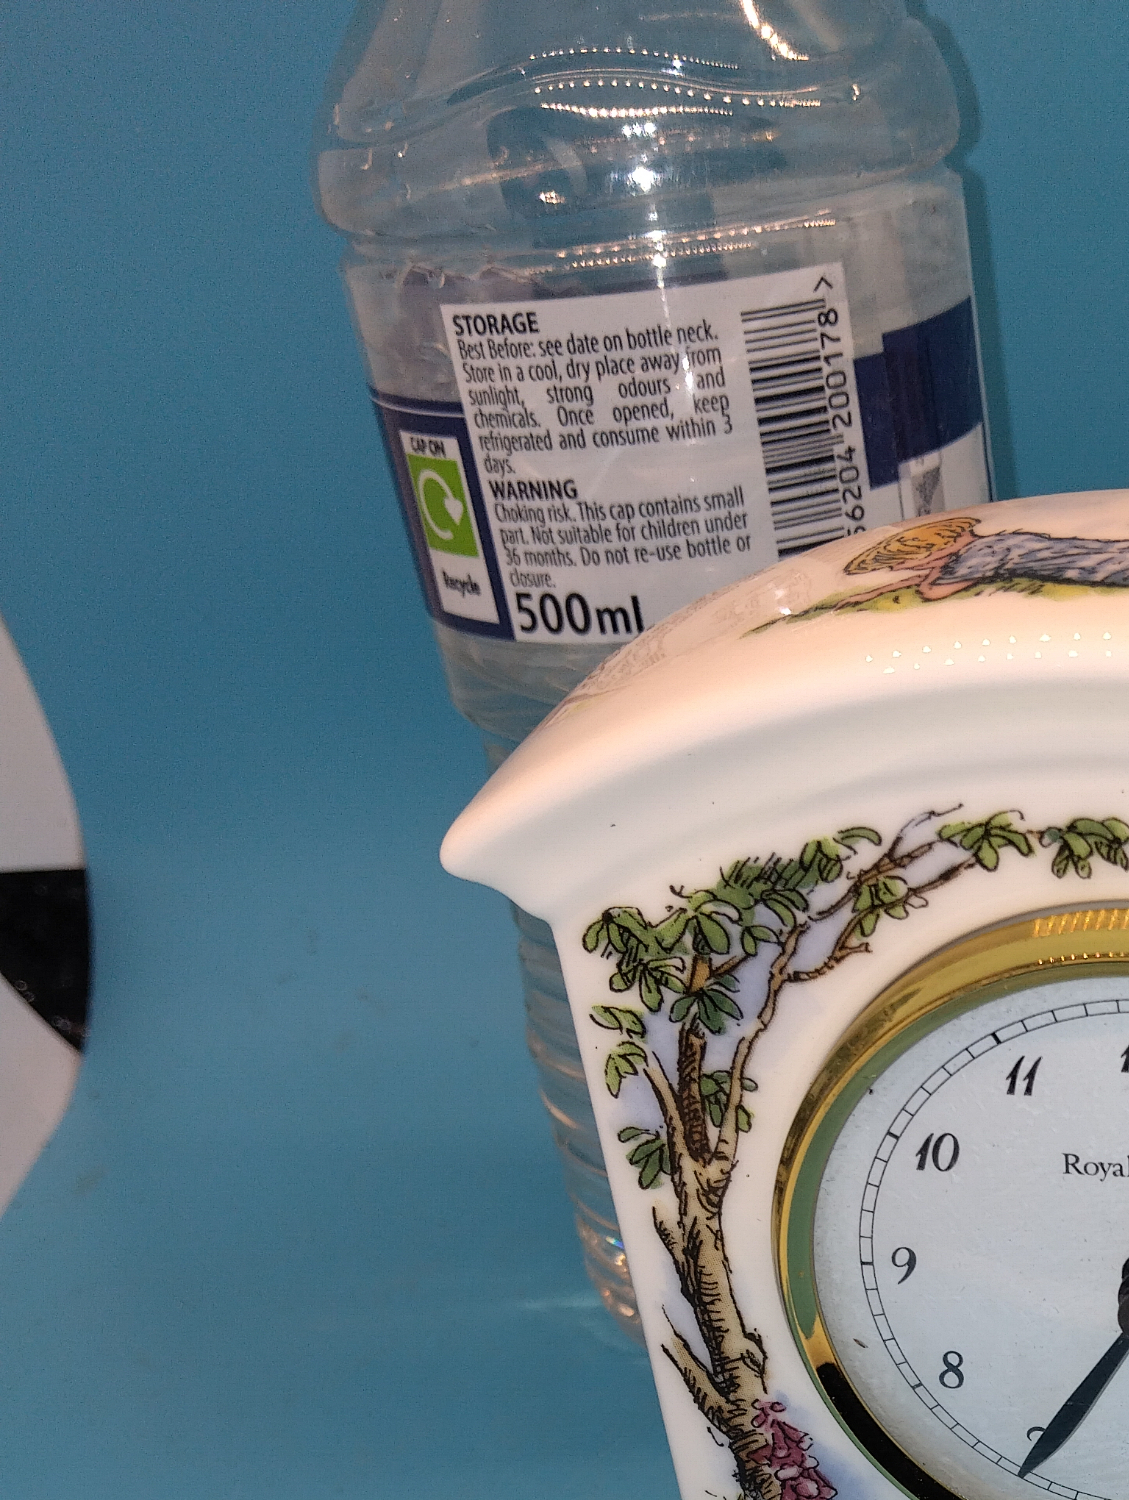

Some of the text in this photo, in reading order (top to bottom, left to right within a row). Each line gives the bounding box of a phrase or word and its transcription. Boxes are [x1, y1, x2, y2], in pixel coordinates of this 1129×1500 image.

[453, 311, 540, 336] STORAGE
[457, 319, 718, 360] Best Before: see date on bottle neck.
[463, 346, 722, 383] Store in a cool, dry place away from
[817, 307, 852, 432] 200178
[468, 366, 726, 412] sunlight, strong odours and
[473, 393, 730, 430] chemicals. Once opened, keep
[478, 413, 733, 457] refrigerated and consume within 3
[483, 452, 516, 479] days.
[488, 479, 578, 502] WARNING
[494, 484, 745, 528] Choking risk. This cap contains small
[500, 509, 749, 552] part. Not suitable for children under
[504, 533, 752, 568] 36 months. Do not re-use bottle or
[510, 567, 557, 590] closure.
[1005, 1055, 1043, 1097] 11
[914, 1132, 960, 1172] 10
[890, 1246, 917, 1285] 9
[938, 1351, 965, 1389] 8
